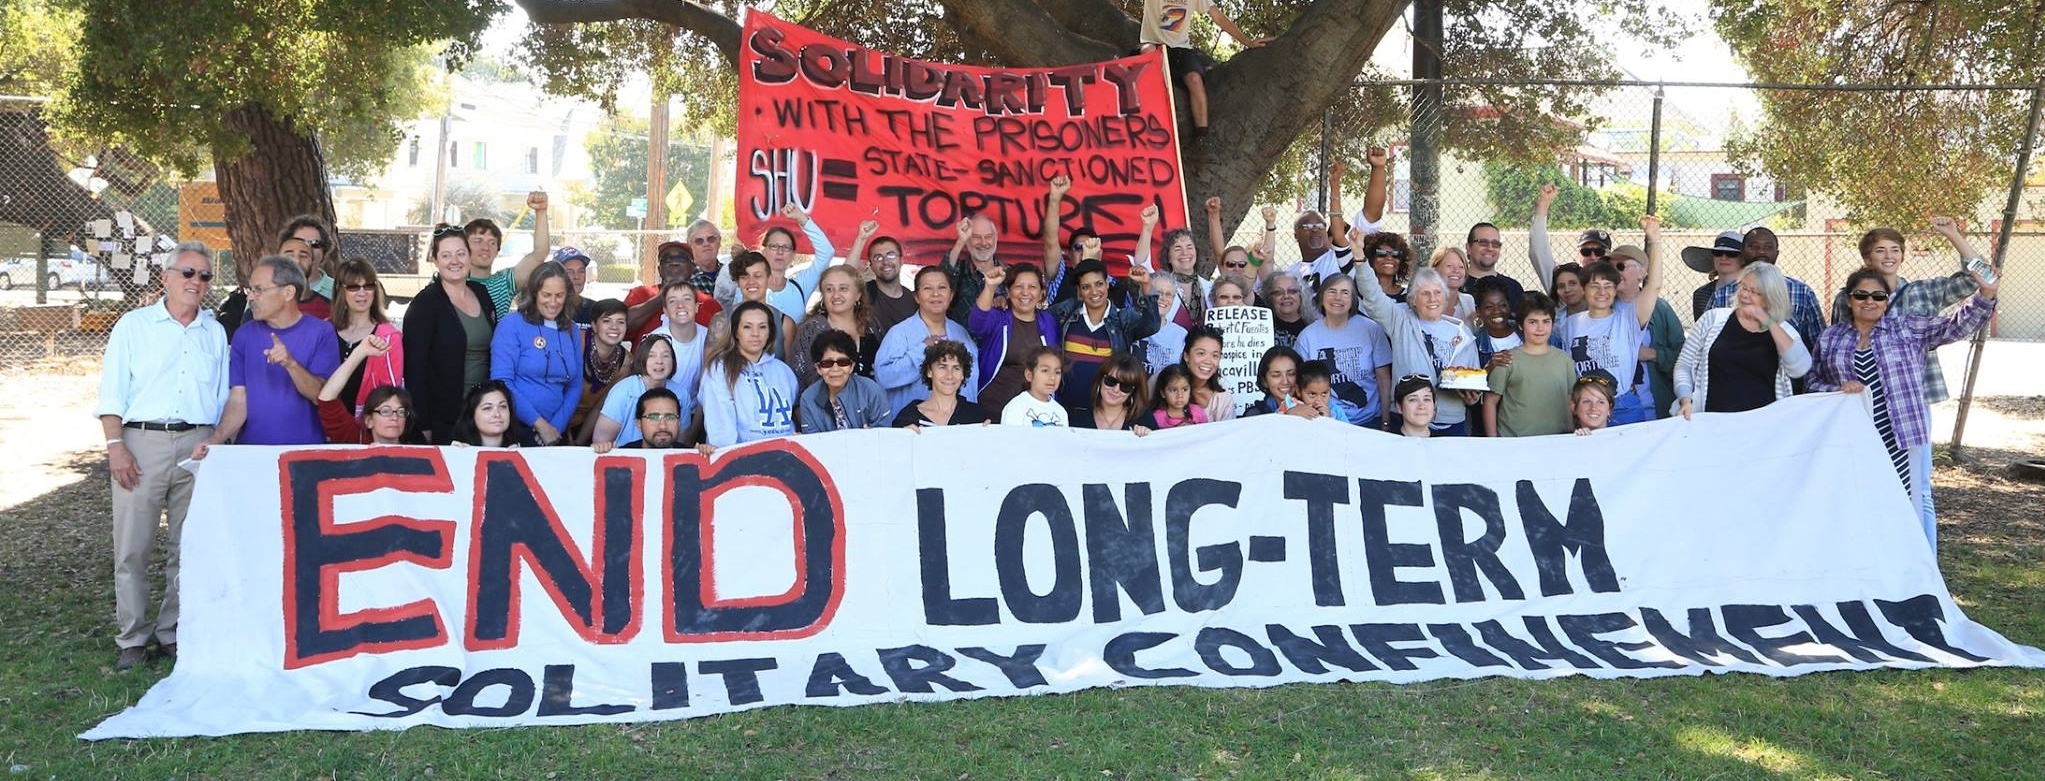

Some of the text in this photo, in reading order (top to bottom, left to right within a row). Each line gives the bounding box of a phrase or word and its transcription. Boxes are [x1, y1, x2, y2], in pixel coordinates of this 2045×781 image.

[748, 26, 1152, 118] SOLIDARITY
[773, 97, 1170, 154] WITH THE PRISONERS
[752, 148, 818, 221] SHU
[1208, 308, 1268, 321] RELEASE
[1237, 335, 1246, 348] he
[1247, 335, 1265, 348] dies
[1252, 349, 1263, 359] in
[1576, 355, 1620, 374] ORTURE
[1331, 369, 1369, 384] RTURE
[754, 379, 792, 427] LA
[277, 438, 846, 670] END
[348, 594, 1990, 718] SOLITARY CONFINEMENT
